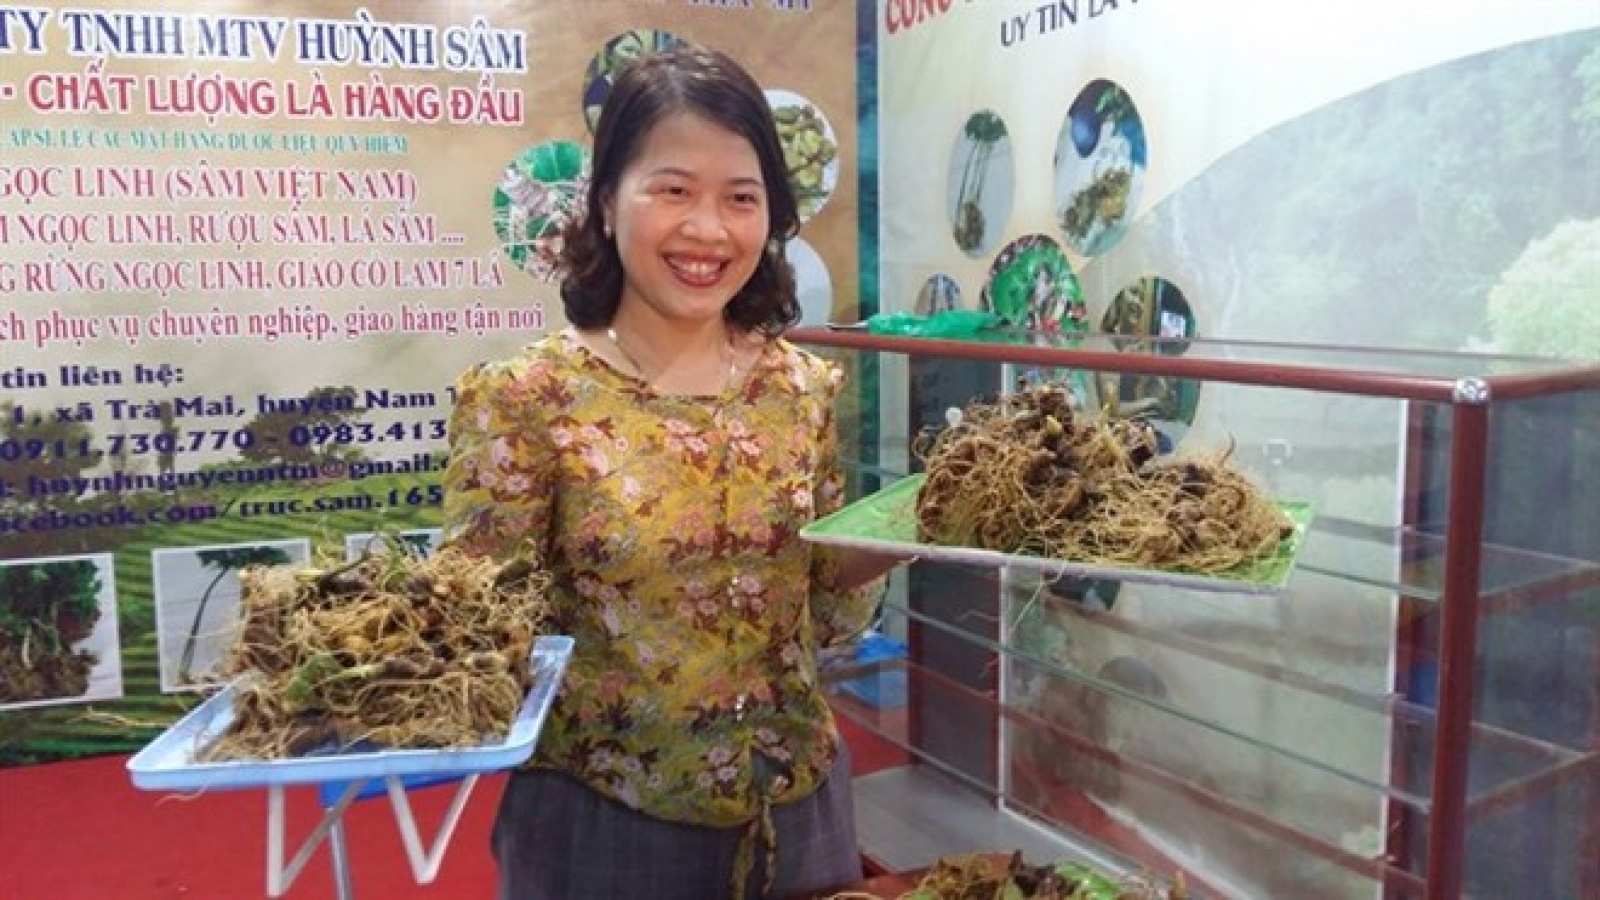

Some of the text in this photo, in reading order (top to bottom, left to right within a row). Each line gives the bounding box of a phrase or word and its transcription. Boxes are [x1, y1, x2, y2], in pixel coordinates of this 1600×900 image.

[63, 13, 184, 54] TNHH
[199, 19, 285, 59] MTV
[299, 12, 434, 64] HUỲNH
[447, 19, 523, 69] SÂM
[29, 58, 135, 109] CHẤT
[148, 73, 275, 123] LƯỢNG
[287, 72, 333, 117] LÀ
[345, 74, 439, 120] HÀNG
[74, 167, 154, 197] LINH
[166, 160, 244, 201] (SÂM
[255, 167, 327, 205] VIỆT
[338, 171, 416, 200] NAM)
[18, 214, 97, 250] NGỌC
[190, 210, 262, 250] RƯỢU
[383, 207, 434, 243] SÂM
[25, 253, 104, 291] RỪNG
[113, 261, 190, 297] NGỌC
[395, 261, 447, 287] LAM
[37, 310, 99, 348] phục
[108, 317, 138, 345] vụ
[149, 306, 238, 344] chuyên
[249, 305, 338, 342] nghiệp,
[344, 305, 393, 337] giao
[402, 304, 457, 336] hàng
[465, 302, 500, 336] tận
[508, 303, 545, 330] nơi
[2, 364, 183, 388] tin liên hệ:
[174, 395, 245, 417] Mai,
[365, 389, 434, 408] Nam
